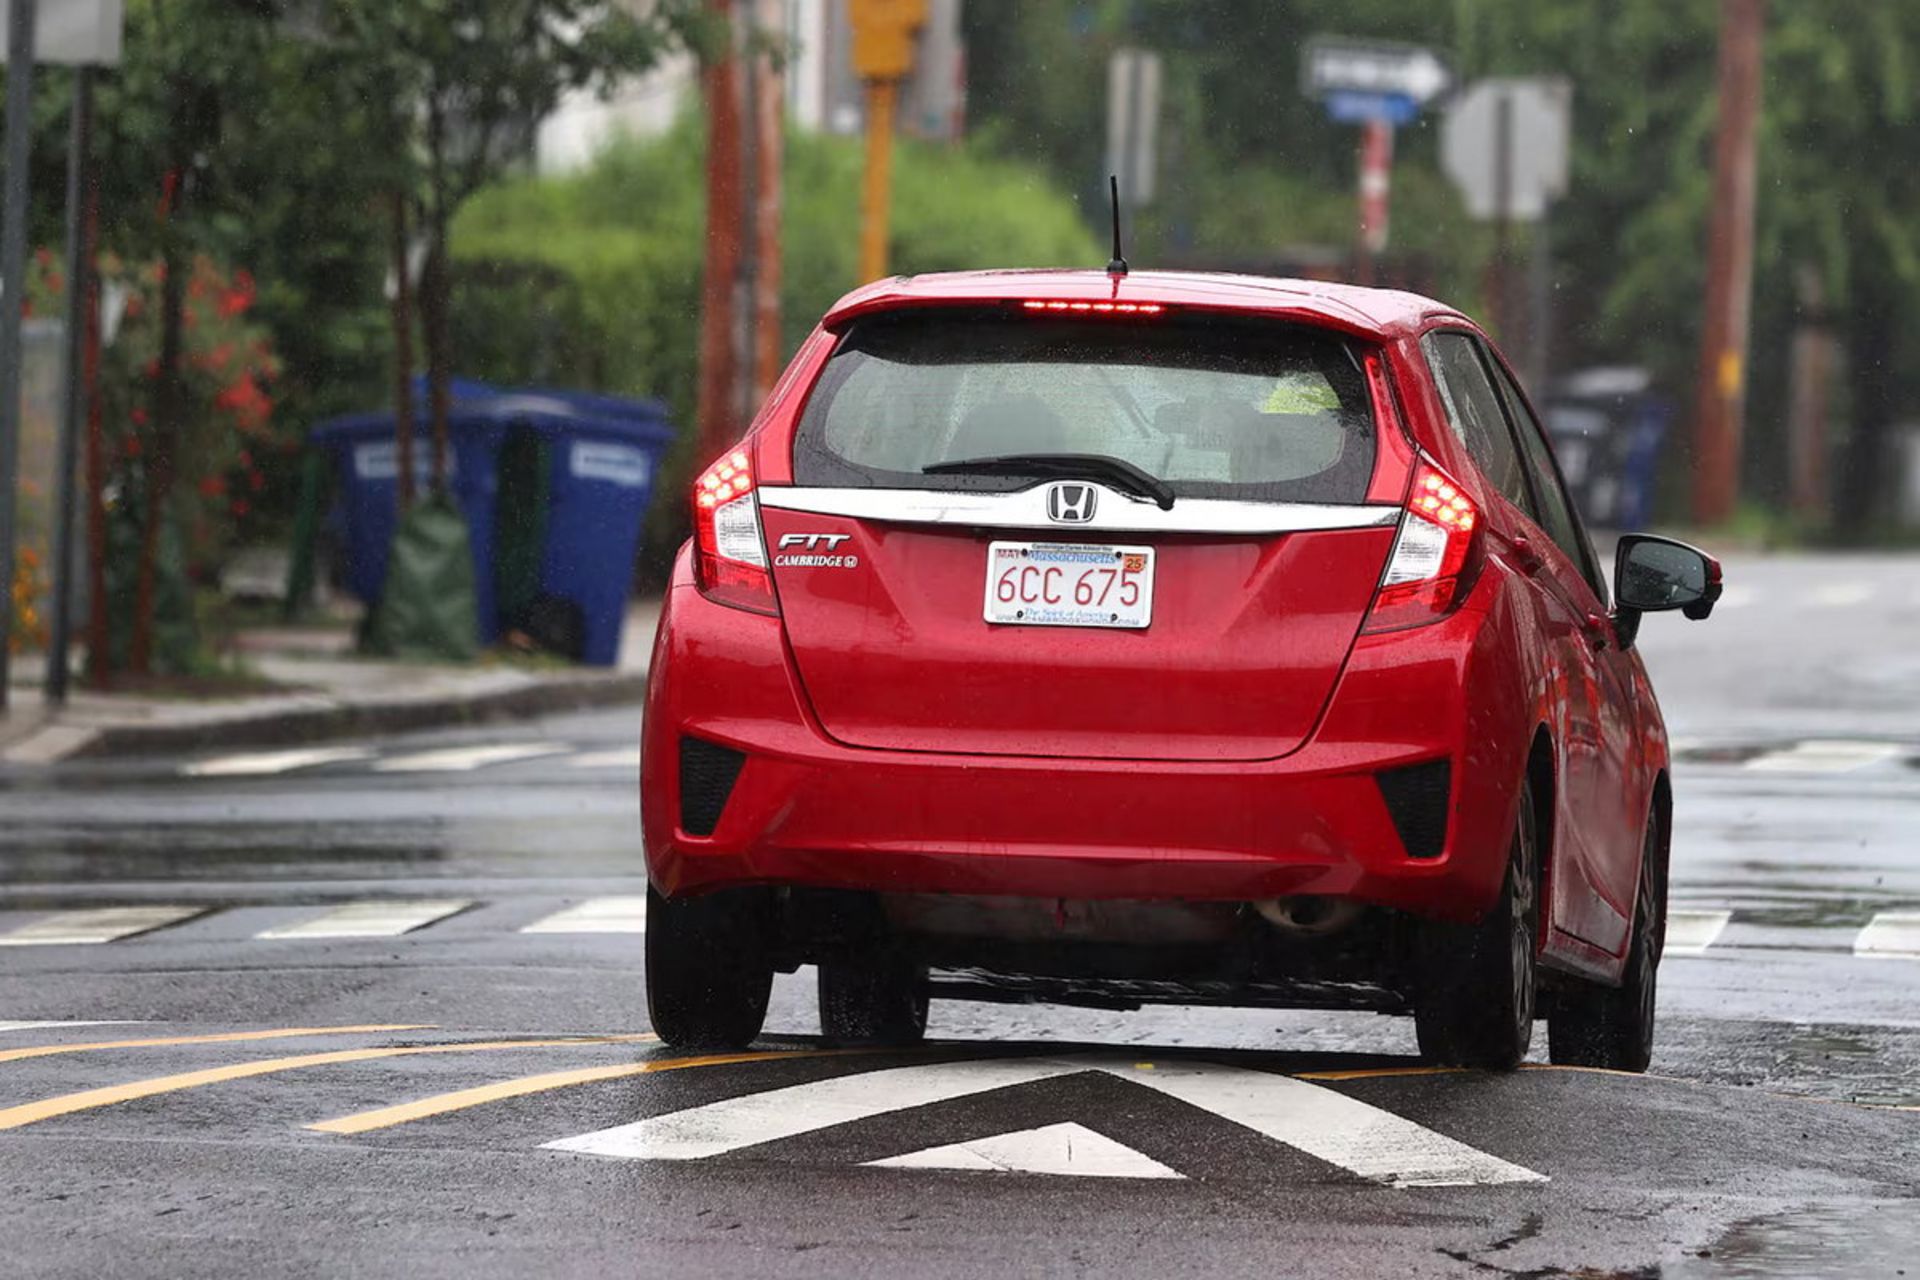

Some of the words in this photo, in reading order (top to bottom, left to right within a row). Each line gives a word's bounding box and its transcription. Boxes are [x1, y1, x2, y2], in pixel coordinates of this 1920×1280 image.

[778, 533, 851, 551] FIT
[775, 554, 843, 568] CAMBRIDGE
[1027, 550, 1117, 564] Massachusetts
[1126, 558, 1142, 569] 25
[998, 566, 1063, 604] 6CC
[1074, 569, 1139, 606] 675
